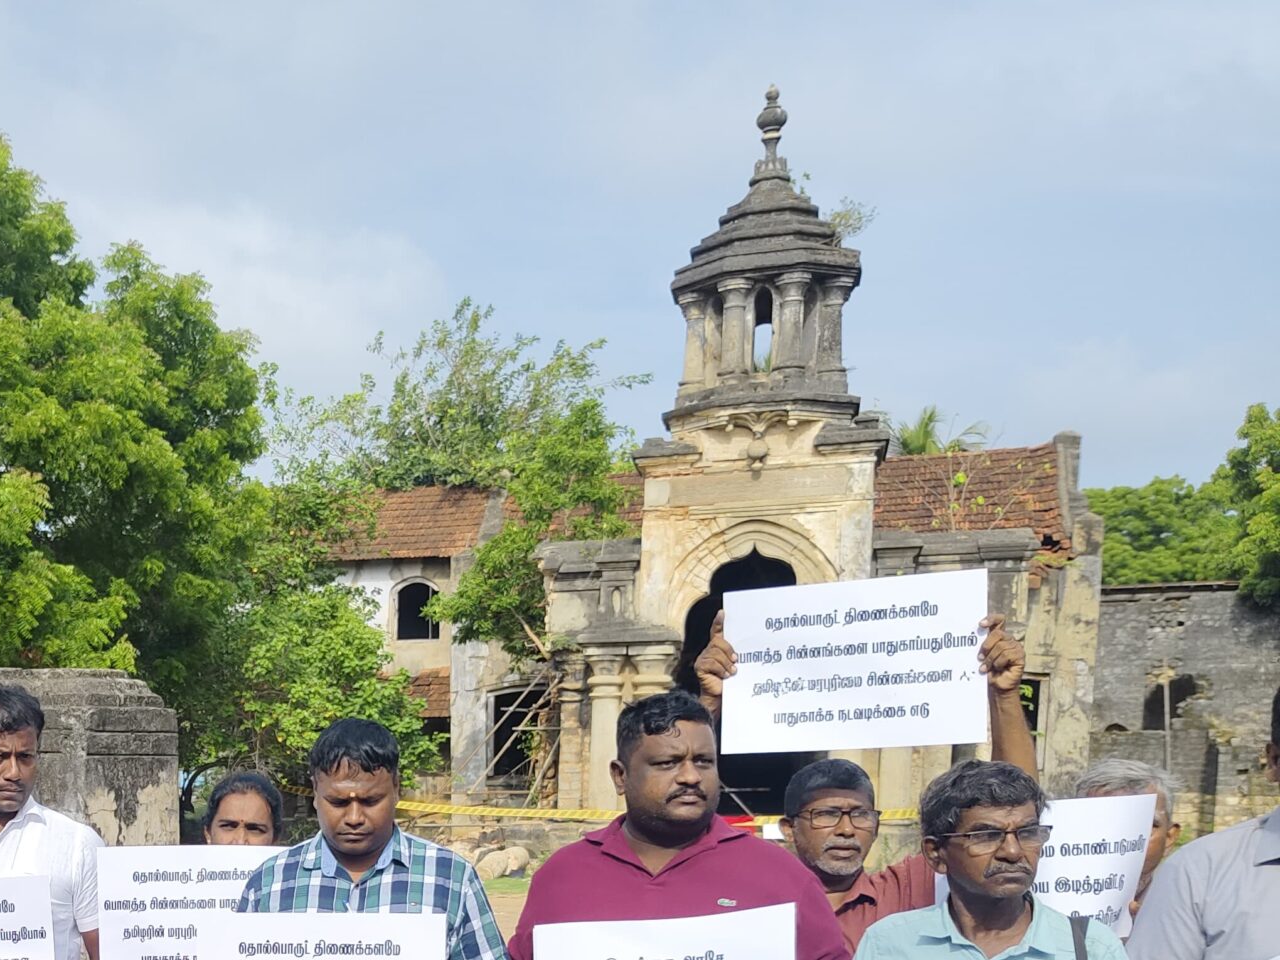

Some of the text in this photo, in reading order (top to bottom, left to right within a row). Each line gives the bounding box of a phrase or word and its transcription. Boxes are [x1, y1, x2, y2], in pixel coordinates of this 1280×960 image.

[786, 642, 868, 660] சின்னங்களை
[773, 702, 930, 727] பாதுகாக்க நடவடிக்கை எடு
[150, 896, 216, 911] சின்னங்களை
[122, 925, 165, 943] தமிழரின்
